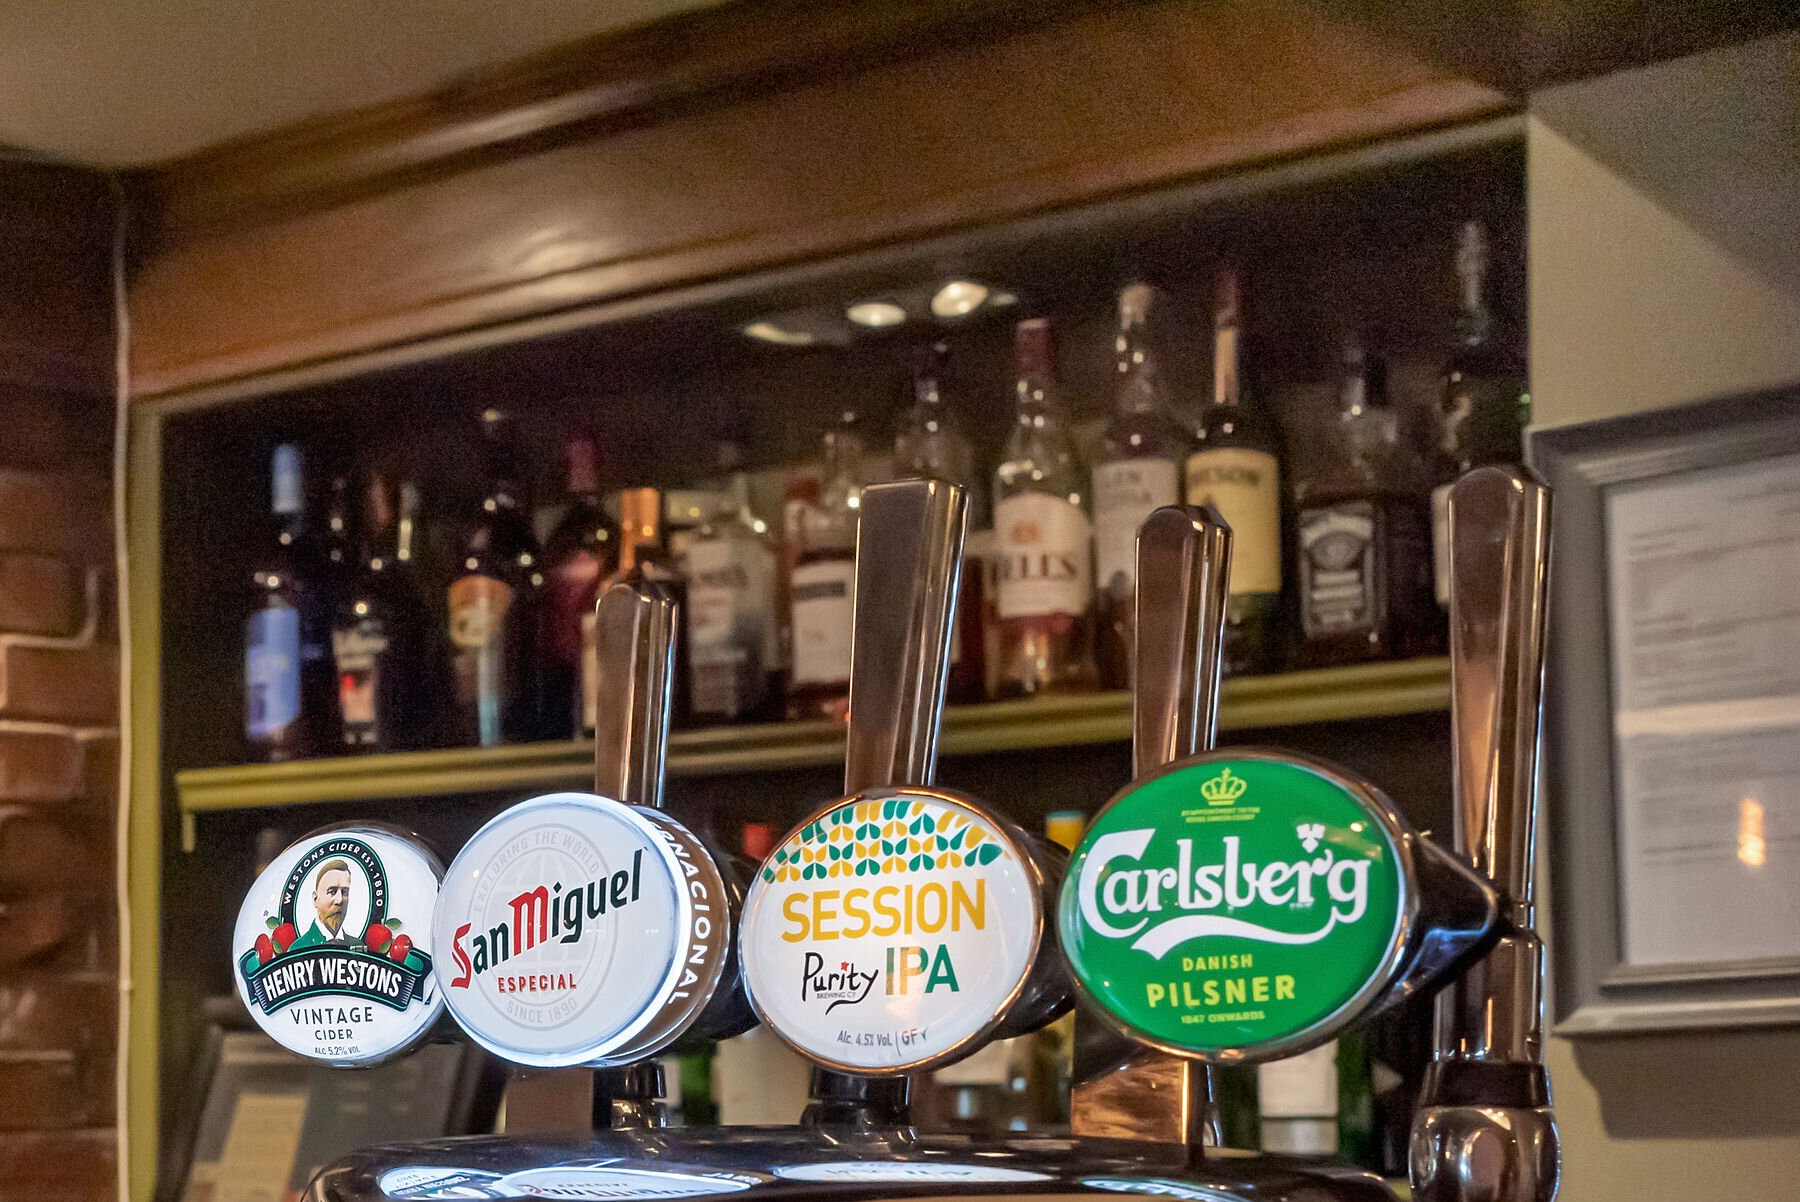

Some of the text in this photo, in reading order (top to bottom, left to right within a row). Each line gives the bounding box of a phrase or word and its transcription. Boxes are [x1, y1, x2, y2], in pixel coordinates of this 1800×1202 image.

[283, 842, 384, 907] WESTONS CIDER EST. 1880
[474, 831, 599, 913] EXPLORING THE WORLD
[1079, 828, 1371, 948] Carlsberg
[781, 878, 986, 943] SESSION
[262, 958, 402, 1001] HENRY WESTONS
[802, 944, 960, 1016] Purity IPA
[1182, 954, 1253, 972] DANISH
[498, 973, 577, 993] ESPECIAL
[1146, 974, 1296, 1008] PILSNER
[290, 1007, 373, 1025] VINTAGE
[506, 997, 578, 1024] SINCE 1890
[315, 1029, 353, 1040] CIDER
